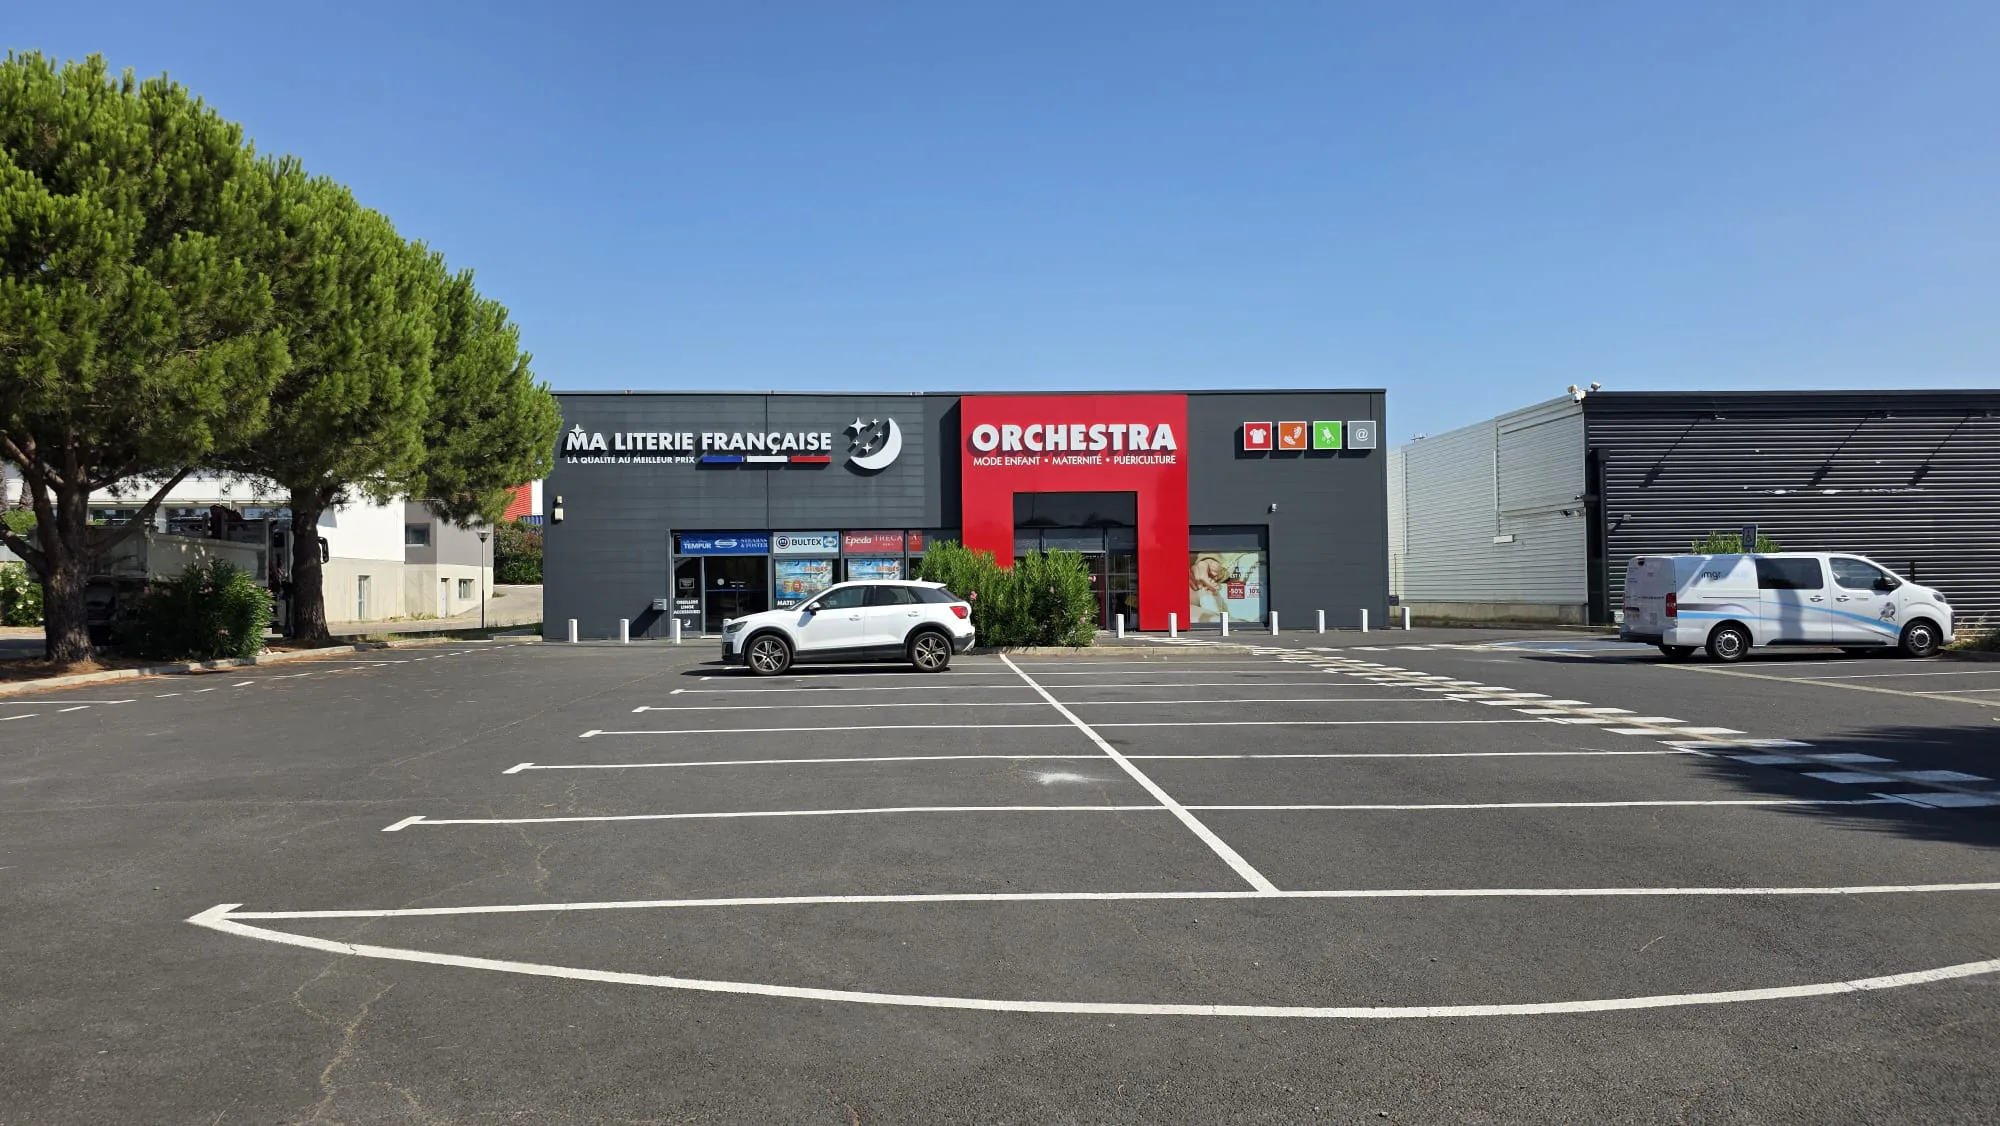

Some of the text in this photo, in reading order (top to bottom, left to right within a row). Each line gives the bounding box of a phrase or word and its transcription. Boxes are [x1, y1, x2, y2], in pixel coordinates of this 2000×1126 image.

[566, 432, 832, 454] MA LITERIE FRANÇAISE
[972, 424, 1178, 452] ORCHESTRA
[580, 454, 616, 464] QUALITÉ
[618, 456, 630, 464] AU
[633, 456, 673, 464] MEILLEUR
[973, 454, 1176, 466] MODE ENFANT MATERNITÉ PUÉRICULTURE
[845, 536, 872, 547] Epeda
